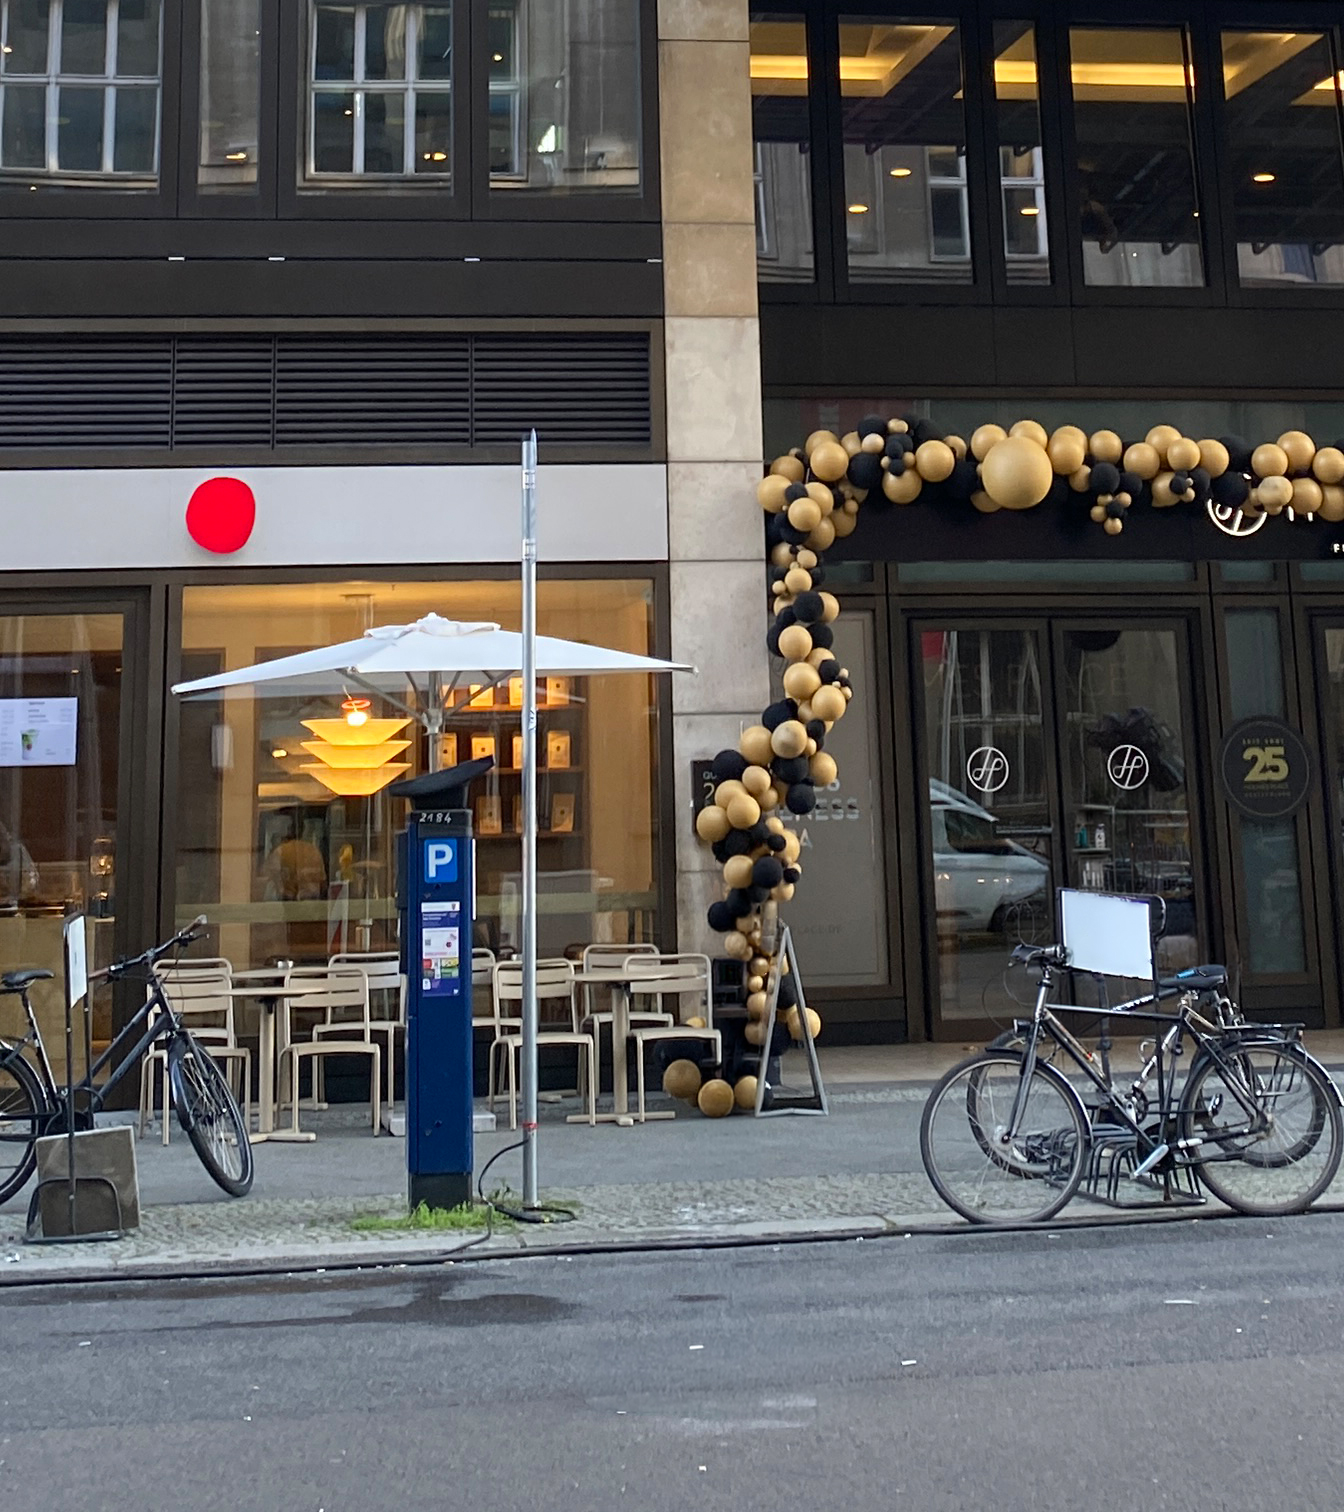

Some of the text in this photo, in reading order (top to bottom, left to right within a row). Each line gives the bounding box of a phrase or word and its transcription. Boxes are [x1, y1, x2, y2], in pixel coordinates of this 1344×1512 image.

[1243, 746, 1289, 782] 25
[419, 812, 452, 824] 2184
[428, 843, 454, 878] P
